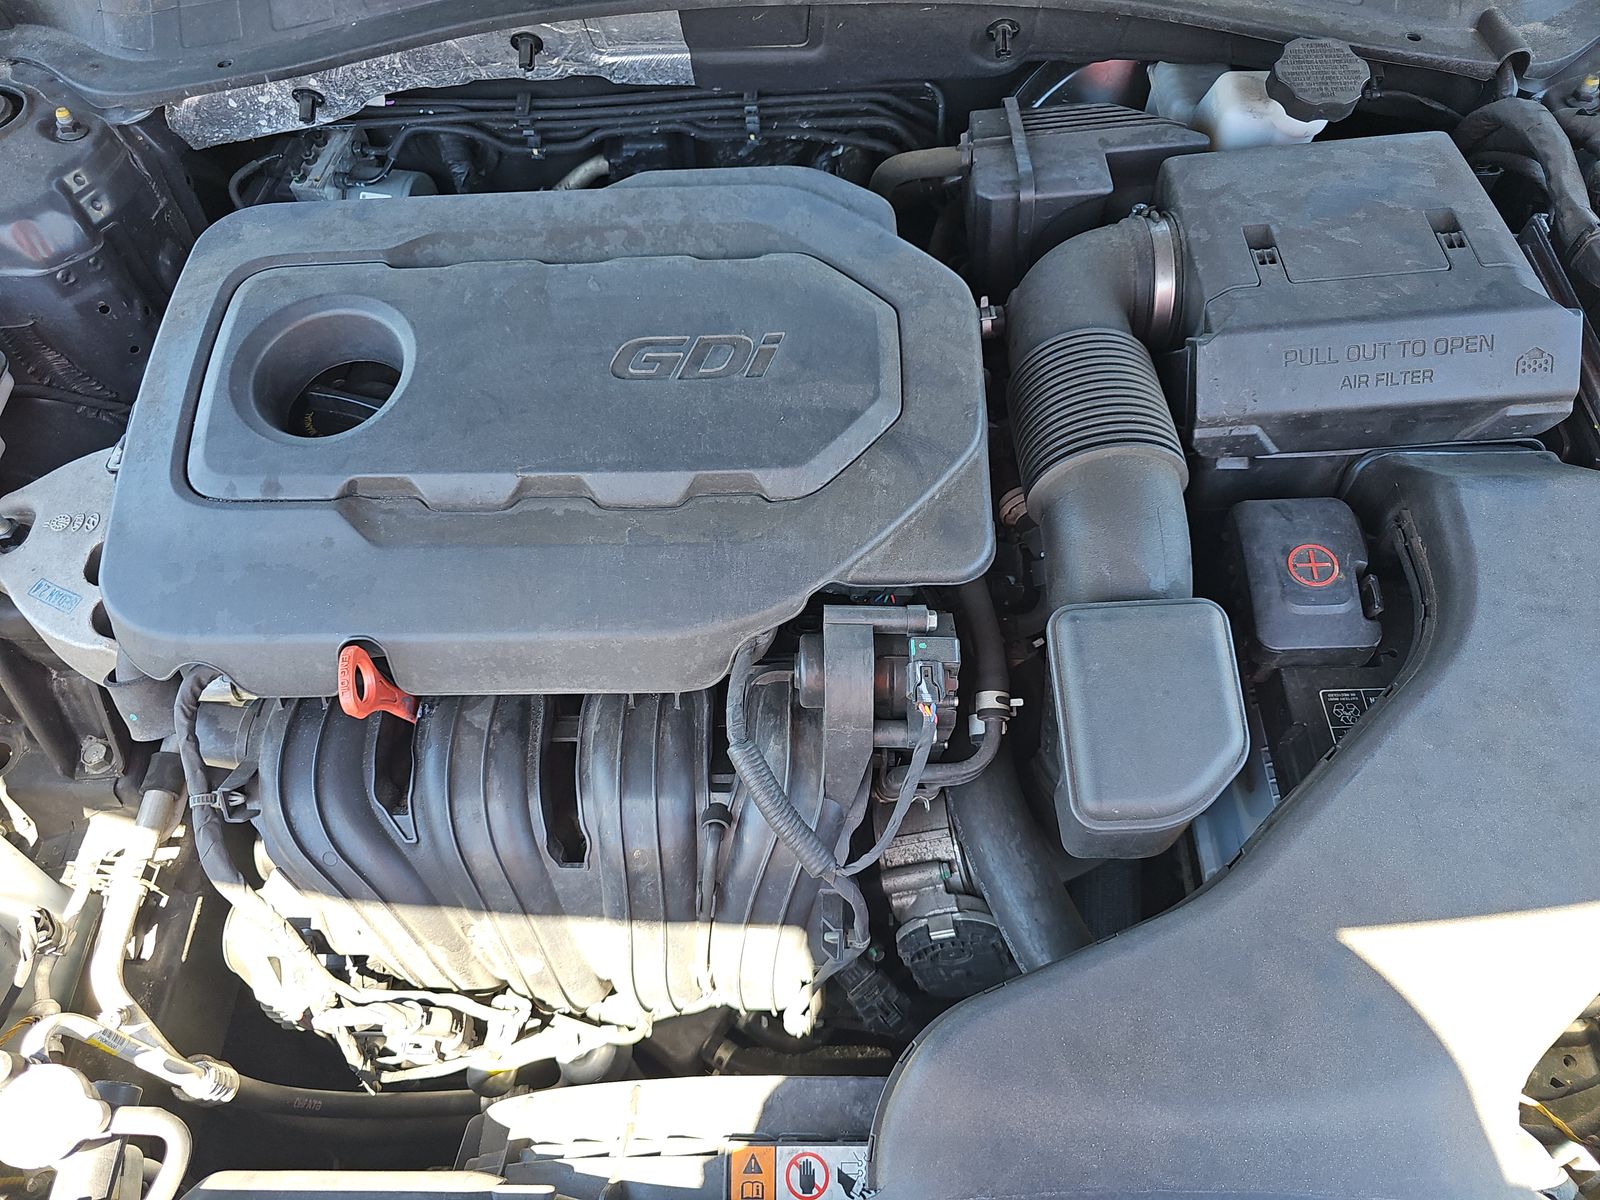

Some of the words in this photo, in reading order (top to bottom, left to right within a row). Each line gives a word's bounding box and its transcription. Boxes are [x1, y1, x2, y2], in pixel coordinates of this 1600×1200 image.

[609, 332, 786, 380] GDi
[1283, 347, 1339, 367] PULL
[1347, 342, 1391, 364] OUT
[1396, 339, 1426, 358] TO
[1433, 334, 1495, 356] OPEN
[1340, 373, 1369, 390] AIR
[1374, 368, 1434, 387] FILTER
[340, 654, 349, 677] ENG
[340, 678, 350, 697] OIL
